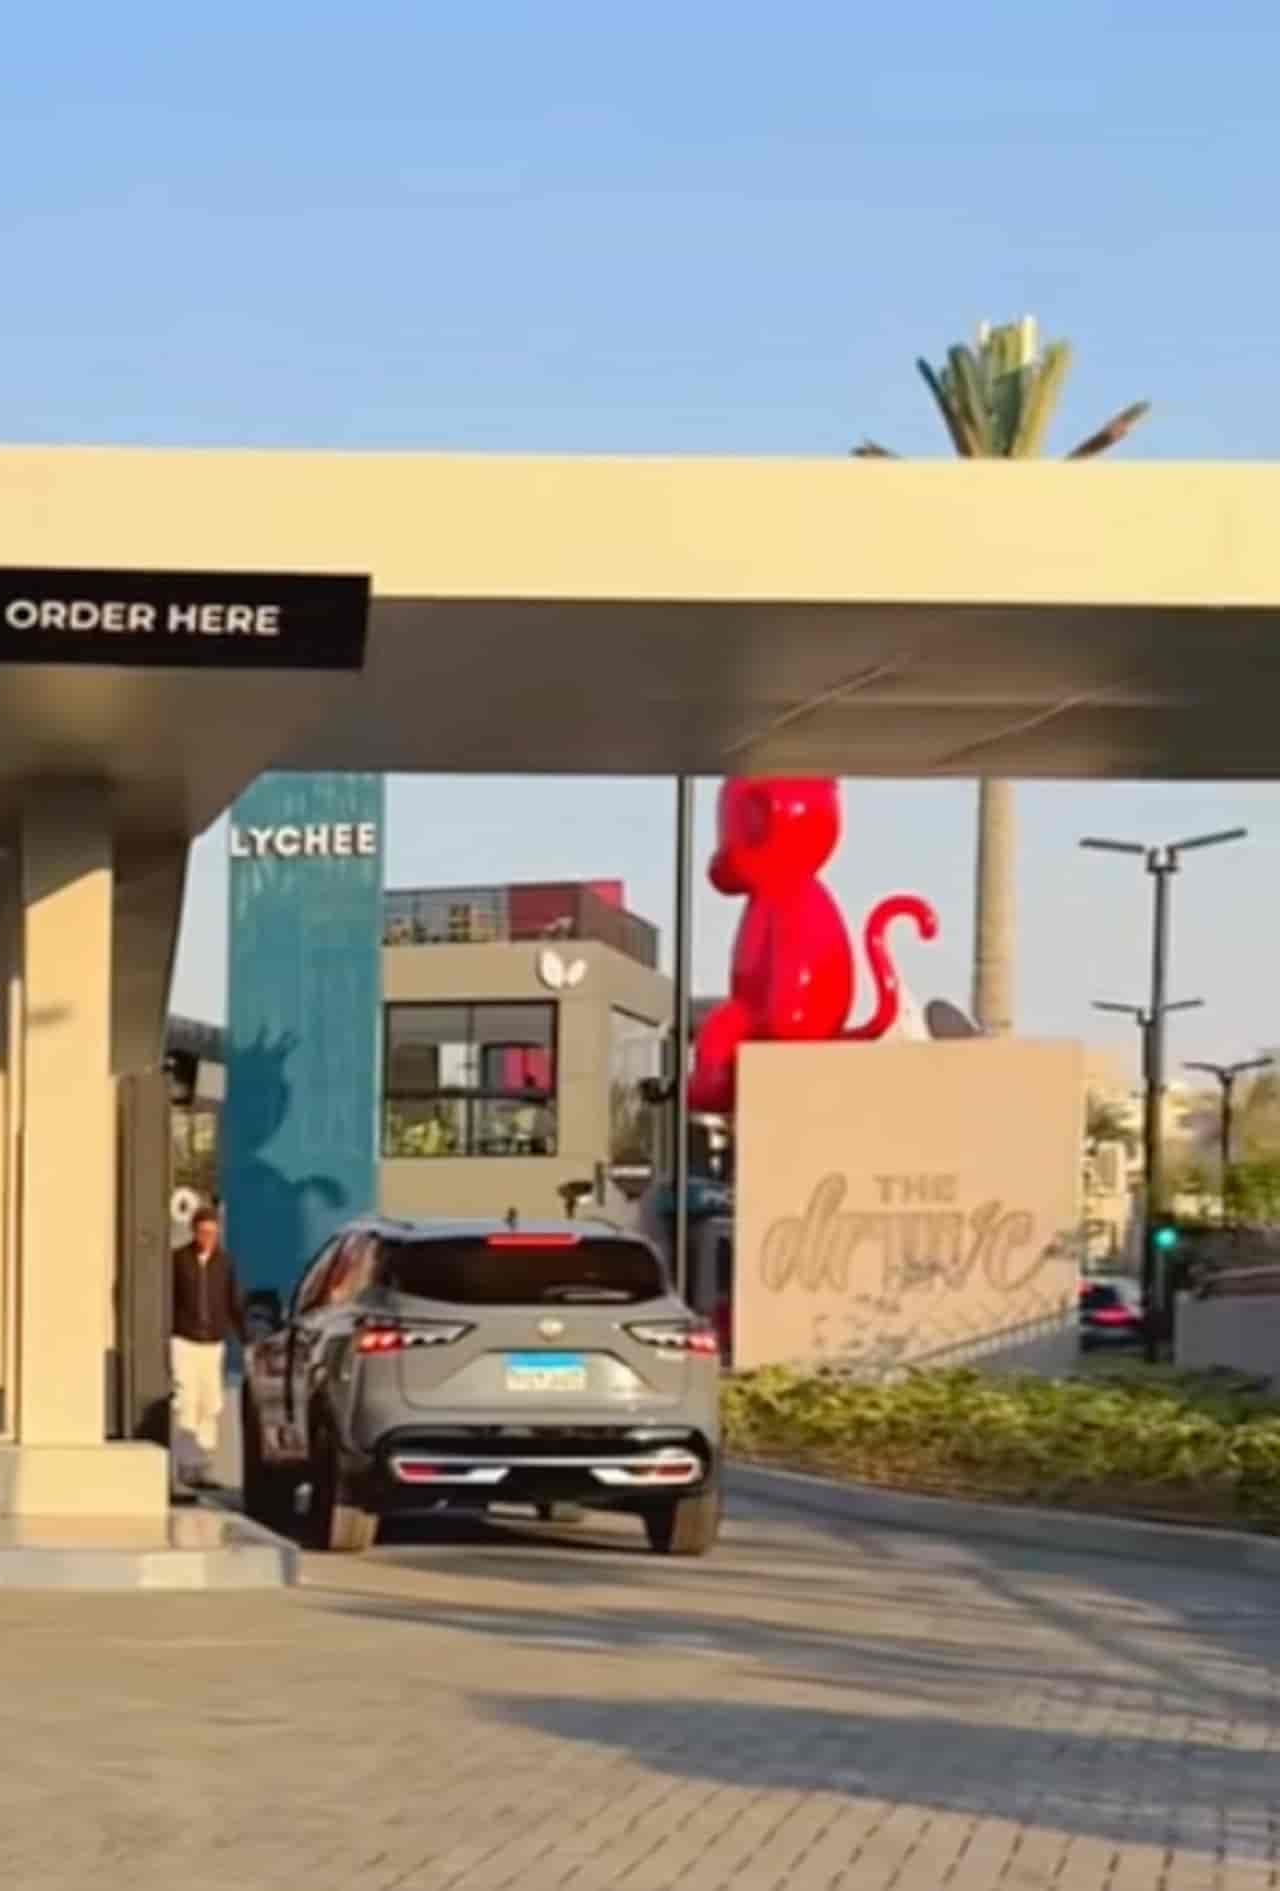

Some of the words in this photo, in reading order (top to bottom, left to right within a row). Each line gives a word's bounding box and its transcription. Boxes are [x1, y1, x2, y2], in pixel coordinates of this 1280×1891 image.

[4, 598, 158, 632] ORDER
[166, 603, 281, 636] HERE
[229, 821, 377, 858] LYCHEE
[872, 1172, 958, 1205] THE
